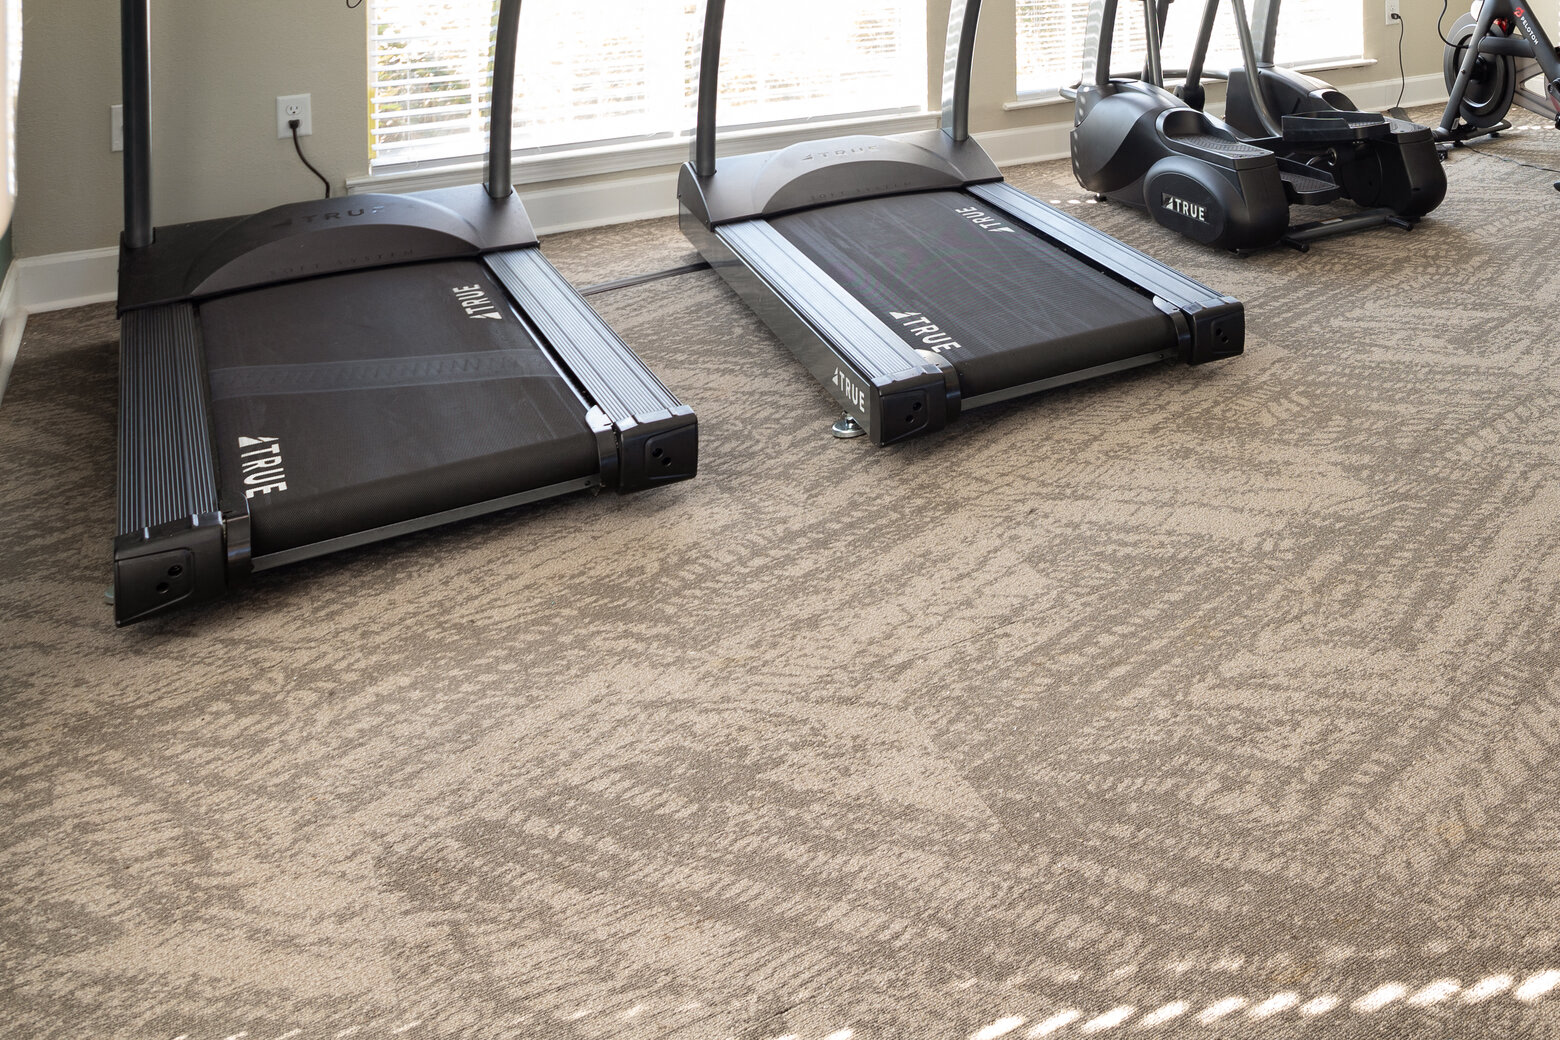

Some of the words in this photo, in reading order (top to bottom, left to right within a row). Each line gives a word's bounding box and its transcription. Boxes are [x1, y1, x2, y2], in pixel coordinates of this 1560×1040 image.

[1520, 16, 1539, 45] PELOTON
[955, 206, 1002, 229] TRUE
[1175, 198, 1205, 222] TRUE
[452, 284, 495, 315] TRUE
[903, 316, 962, 353] TRUE
[839, 370, 865, 413] TRUE
[241, 443, 288, 499] TRUE
